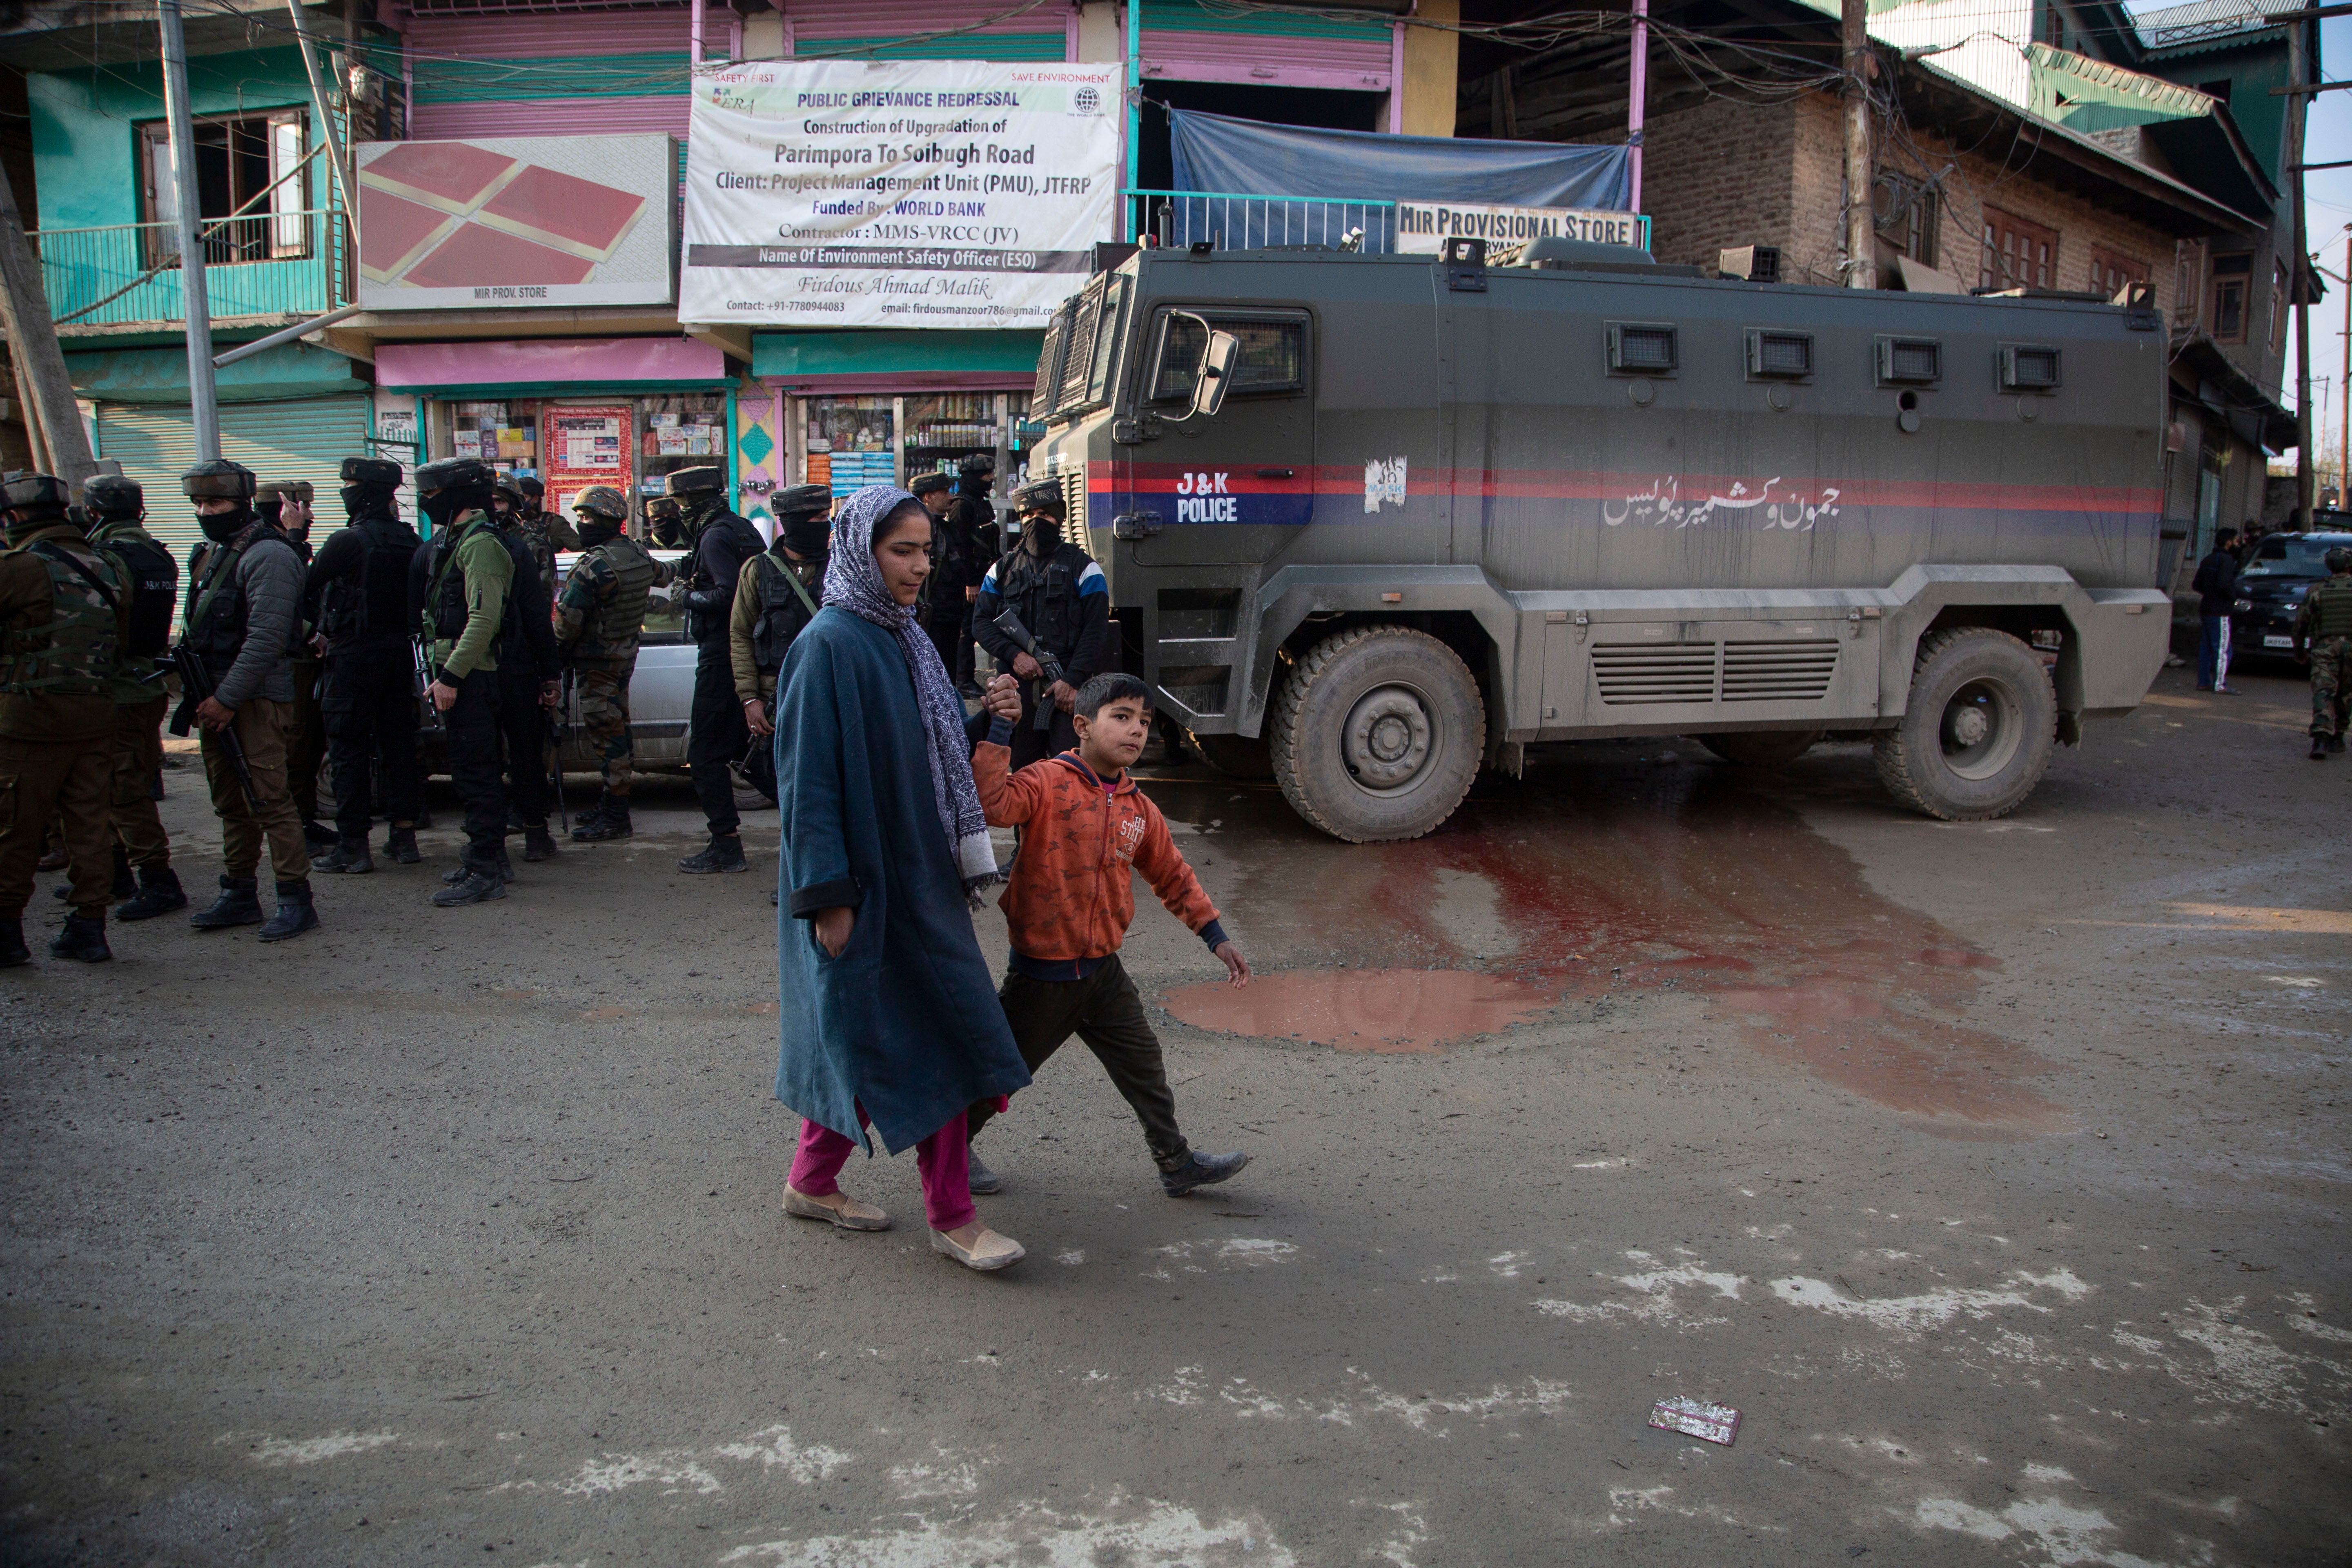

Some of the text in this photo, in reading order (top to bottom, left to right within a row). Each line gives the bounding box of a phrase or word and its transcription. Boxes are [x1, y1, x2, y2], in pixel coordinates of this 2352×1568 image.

[715, 74, 775, 83] SAFETY FIRST
[1011, 73, 1110, 83] SAVE ENVIRONMENT
[797, 91, 1020, 107] PUBLIC GRIEVANCE REDRESSAL
[804, 119, 1007, 137] Construction of Upgradation of
[775, 143, 1035, 168] Parimpora To Soibugh Road
[715, 172, 1091, 196] Client: Project Management Unit (PMU), JTFRP
[812, 200, 864, 216] Funded
[867, 201, 884, 218] By
[895, 200, 944, 216] WORLD
[947, 202, 986, 217] BANK
[778, 223, 862, 239] Contractor
[873, 224, 980, 240] MMS-VRCC
[983, 226, 1019, 245] (JV)
[1400, 206, 1630, 244] MIR PROVISIONAL STORE
[759, 247, 1037, 270] Name Of Environment Safety Officer (ESO)
[474, 287, 548, 299] MIR PROV. STORE
[797, 274, 993, 300] Firdous Ahmad Malik
[726, 300, 845, 313] Contact: +91-7780944083
[880, 303, 1056, 317] email: firdousmanzoor786@gmail.co
[1178, 497, 1237, 523] POLICE
